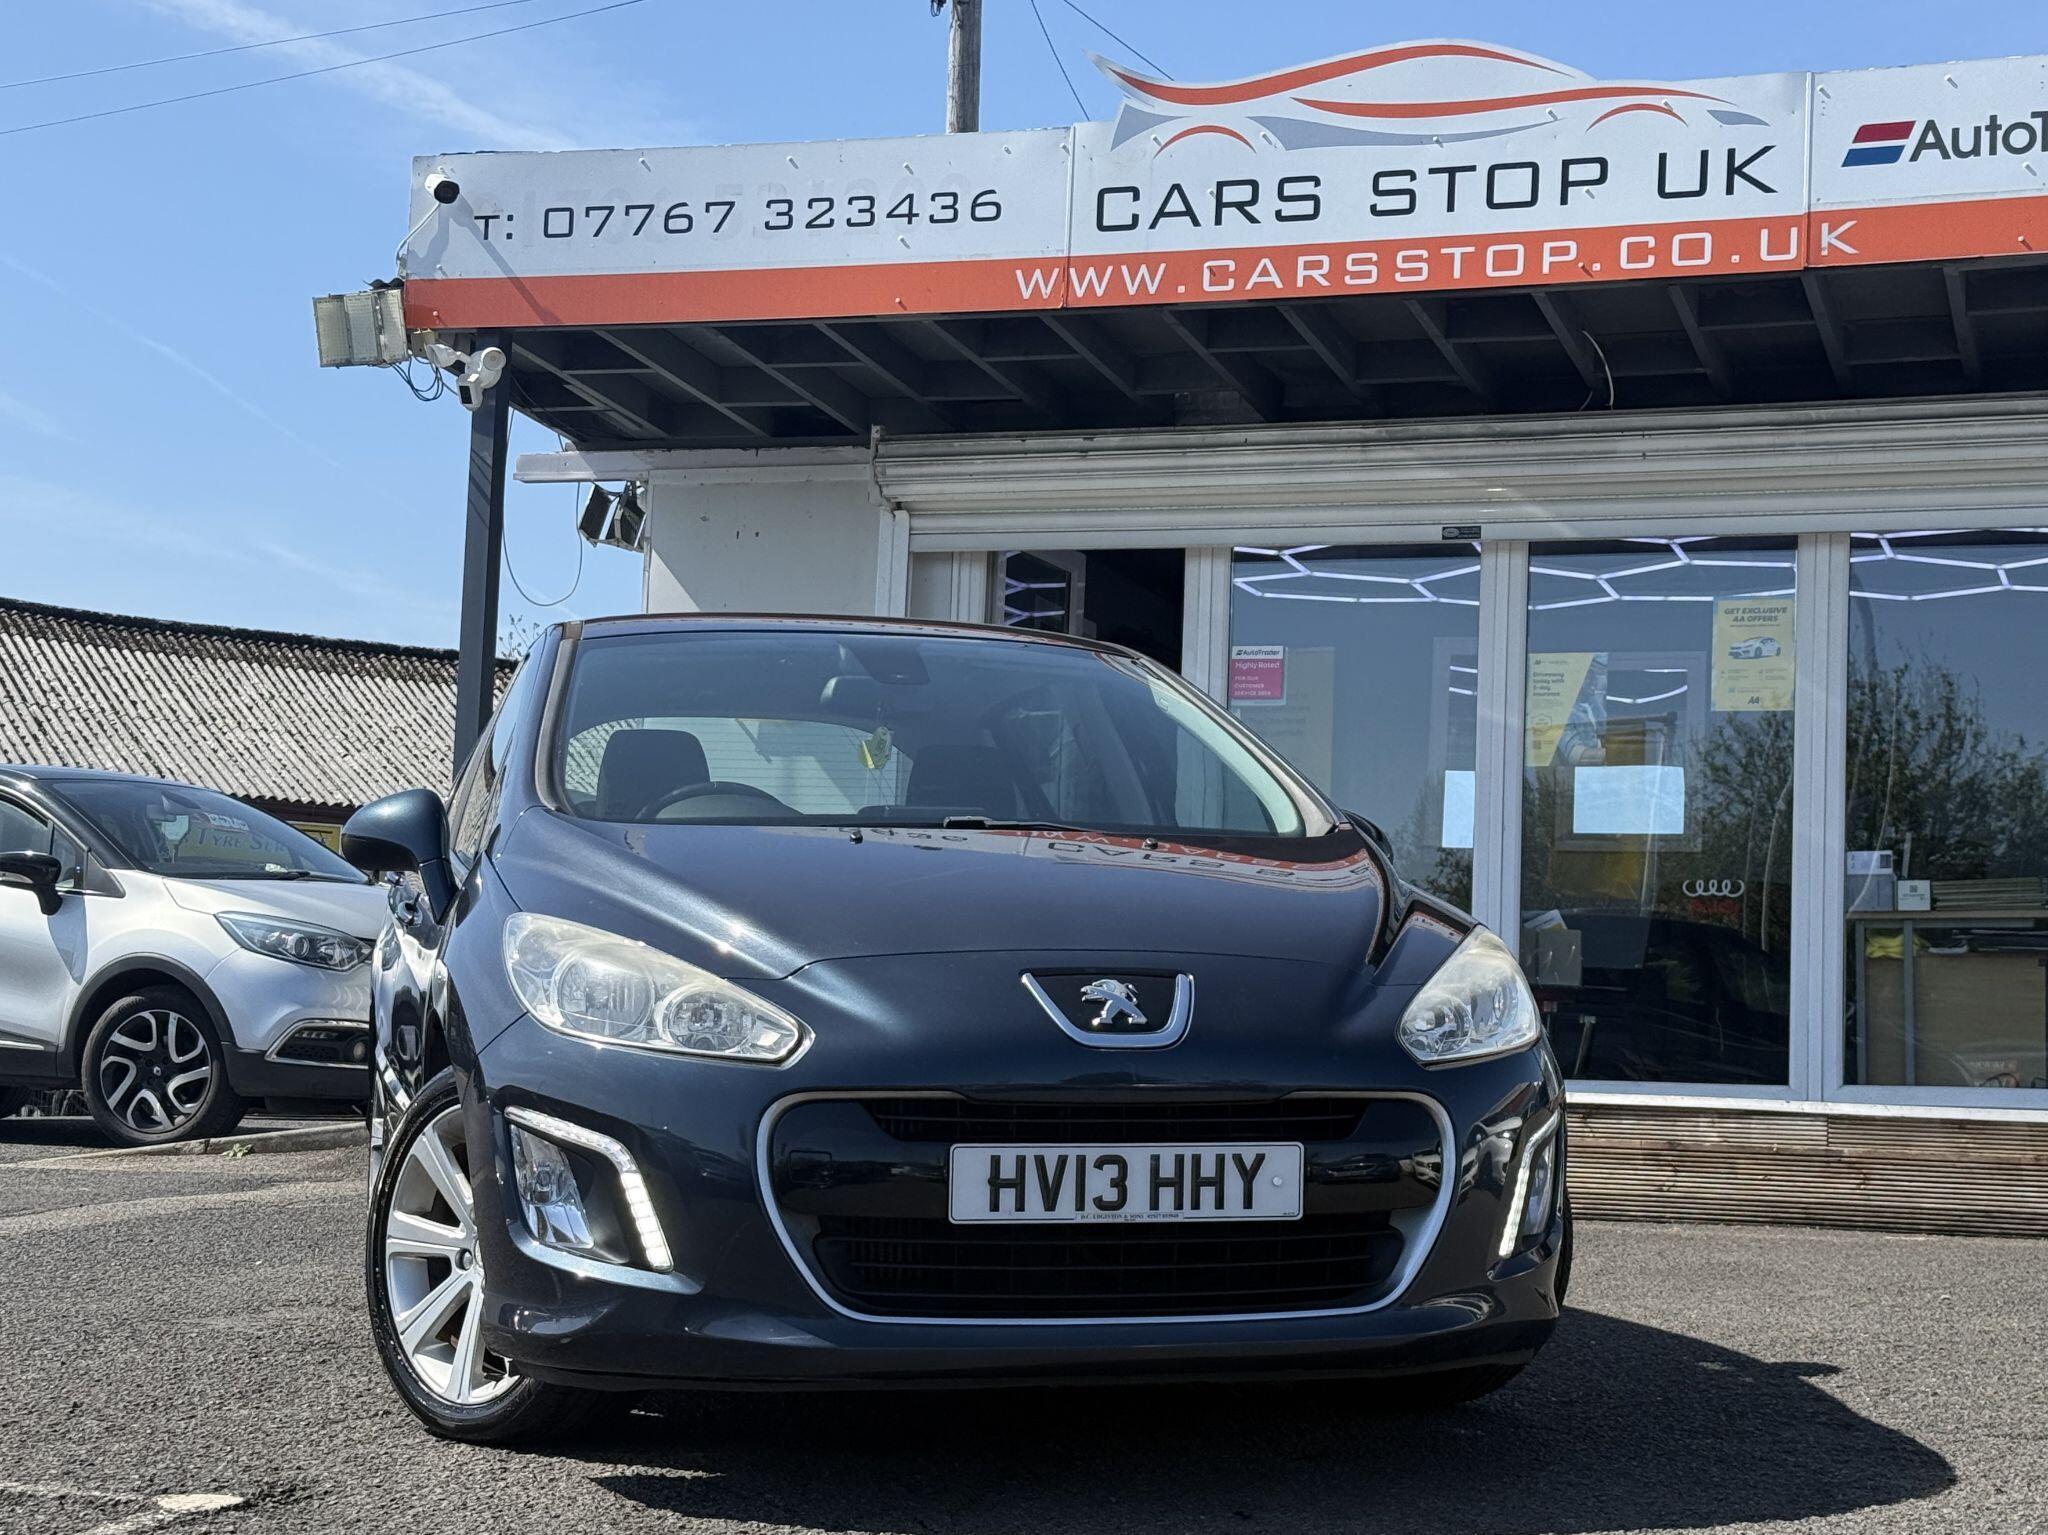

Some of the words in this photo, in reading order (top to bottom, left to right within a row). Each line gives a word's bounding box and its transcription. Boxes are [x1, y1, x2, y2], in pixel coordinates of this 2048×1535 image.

[542, 200, 737, 240] 07767
[763, 188, 1004, 232] 323436
[1095, 174, 1323, 233] CARS
[1370, 155, 1610, 219] STOP
[1657, 144, 1779, 200] UK
[1015, 219, 1859, 301] WWW.CARSSTOP.CO.UK
[1724, 607, 1741, 615] GET
[1742, 606, 1788, 615] EXCLUSIVE
[1235, 661, 1257, 670] Highly
[1258, 661, 1280, 669] Rated
[1747, 696, 1760, 704] AA
[988, 1154, 1129, 1212] HV13
[1149, 1152, 1267, 1211] HHY
